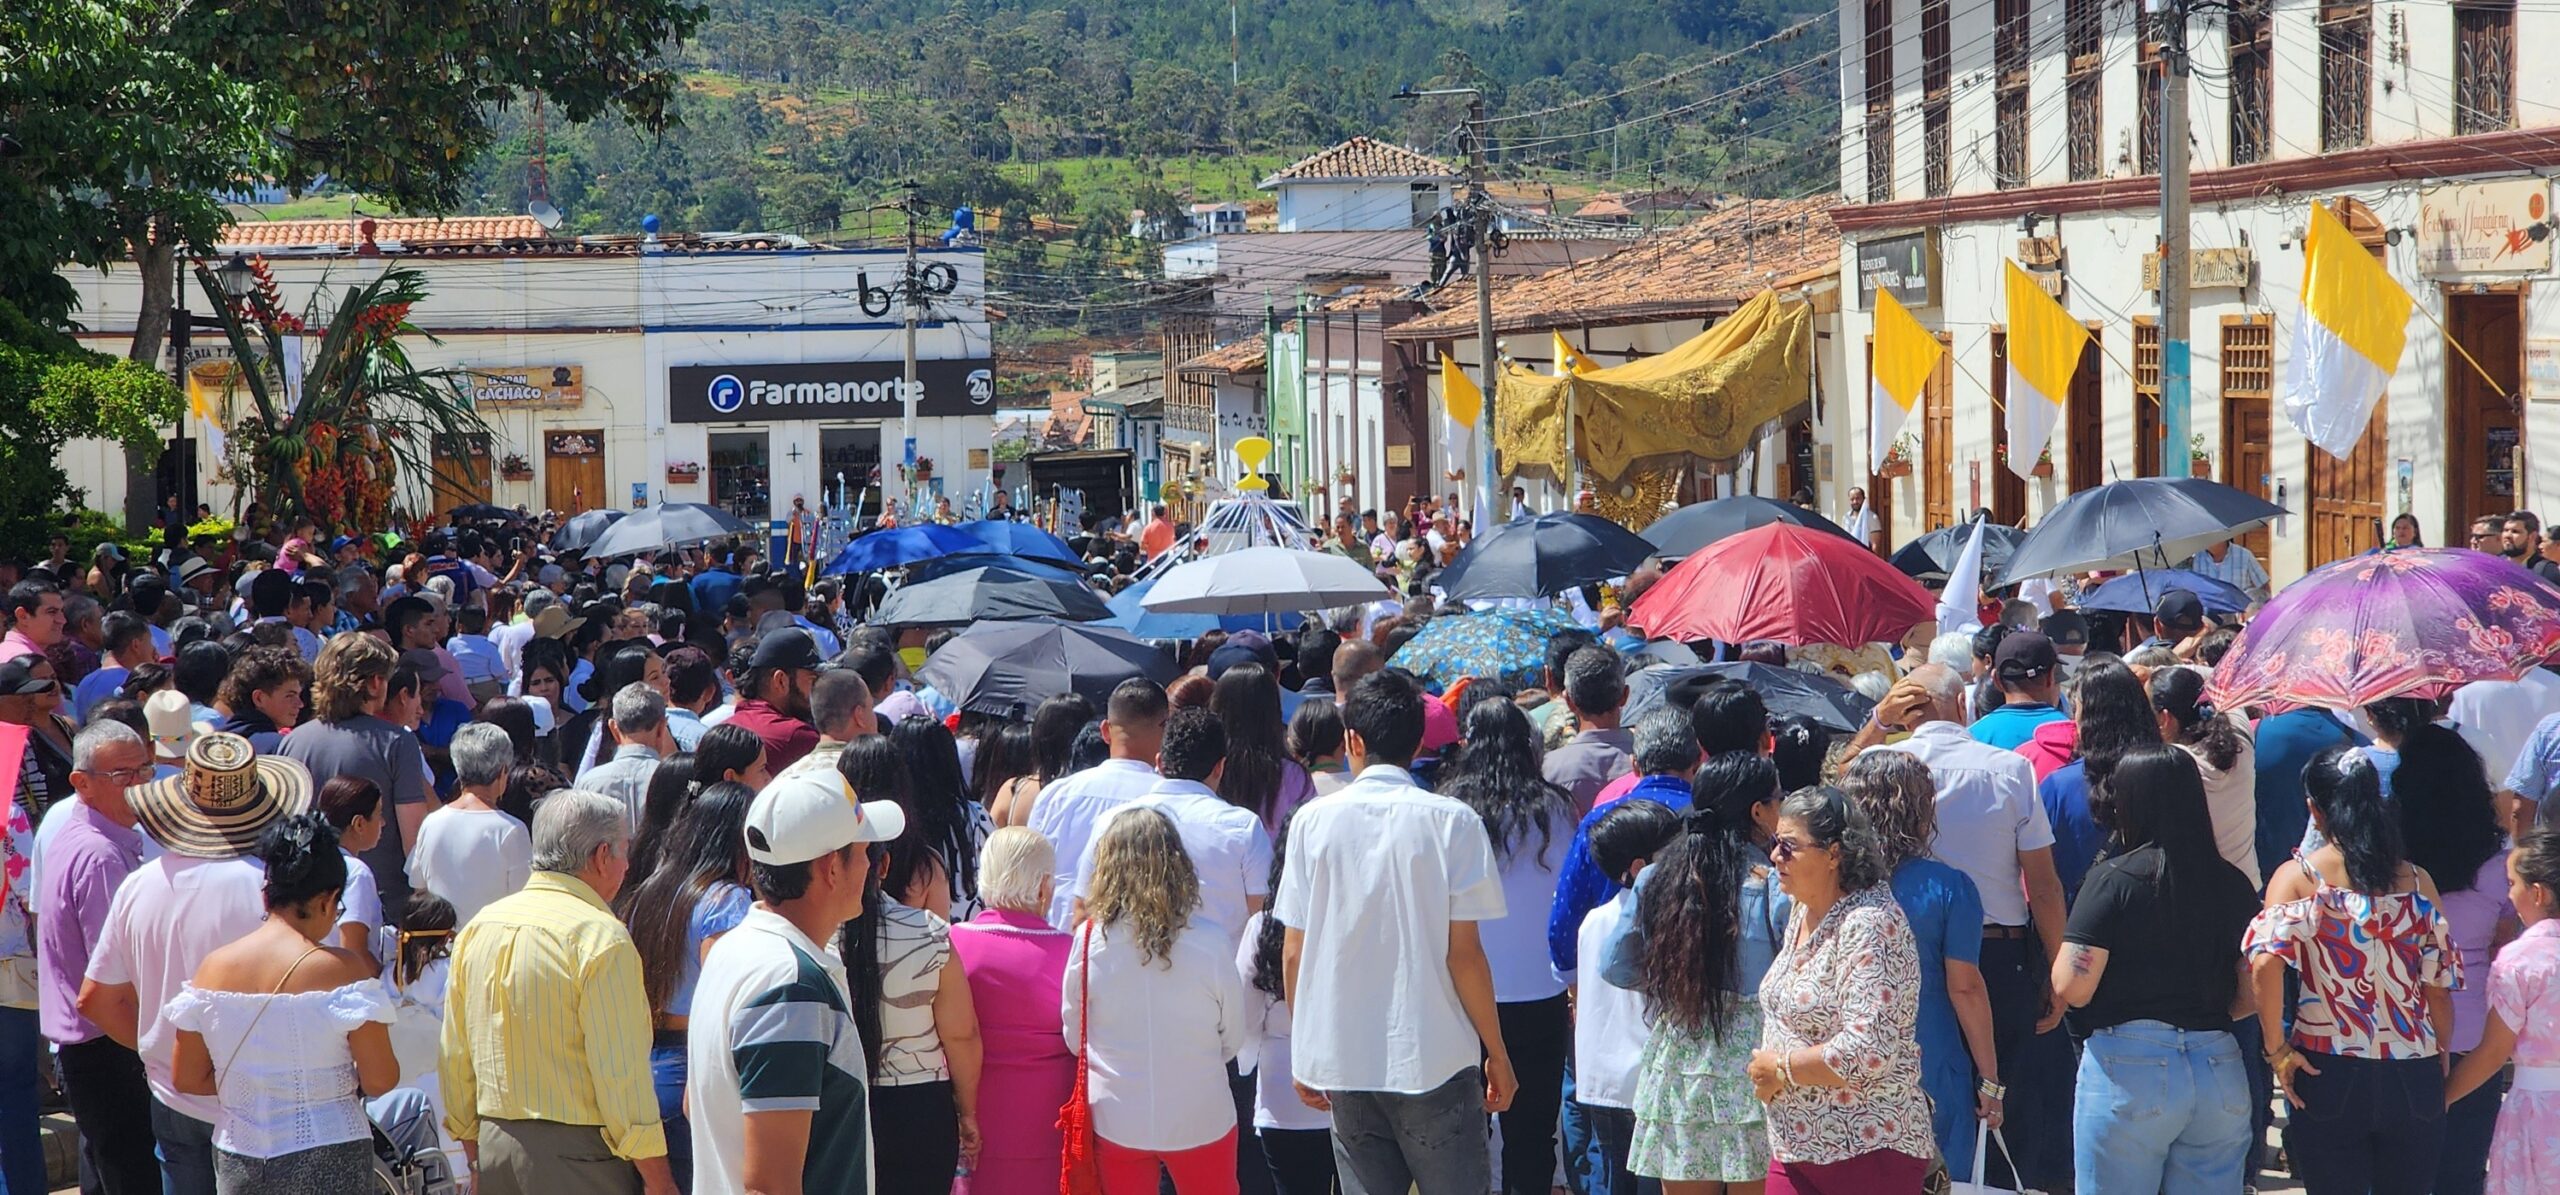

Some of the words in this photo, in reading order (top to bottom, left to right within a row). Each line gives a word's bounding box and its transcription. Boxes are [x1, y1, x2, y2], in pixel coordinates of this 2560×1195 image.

[475, 386, 543, 401] CACHACO
[749, 376, 925, 406] Farmanorte
[970, 378, 990, 399] 24
